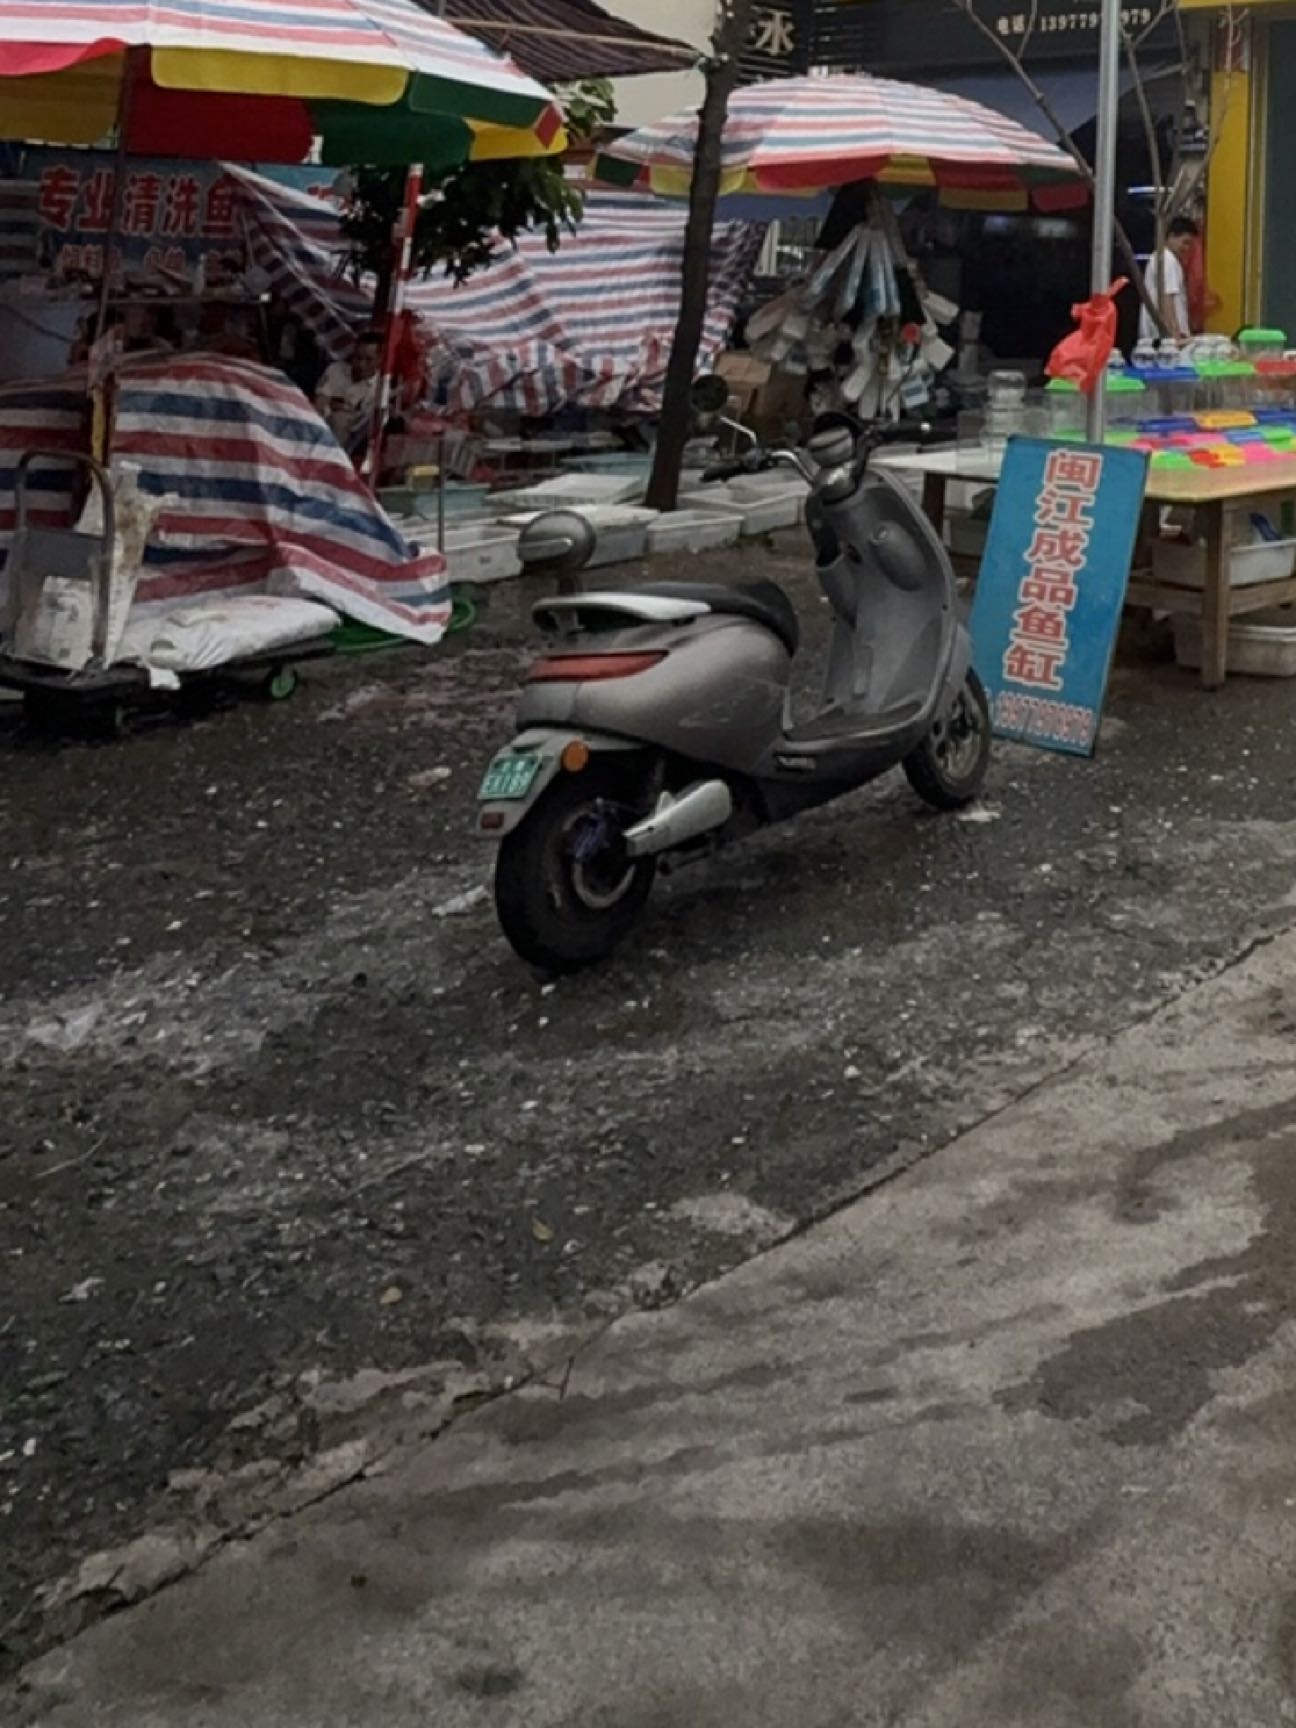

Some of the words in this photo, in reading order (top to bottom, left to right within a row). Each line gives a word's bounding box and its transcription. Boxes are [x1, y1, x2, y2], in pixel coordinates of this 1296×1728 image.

[1002, 449, 1103, 691] 闽江成品鱼缸
